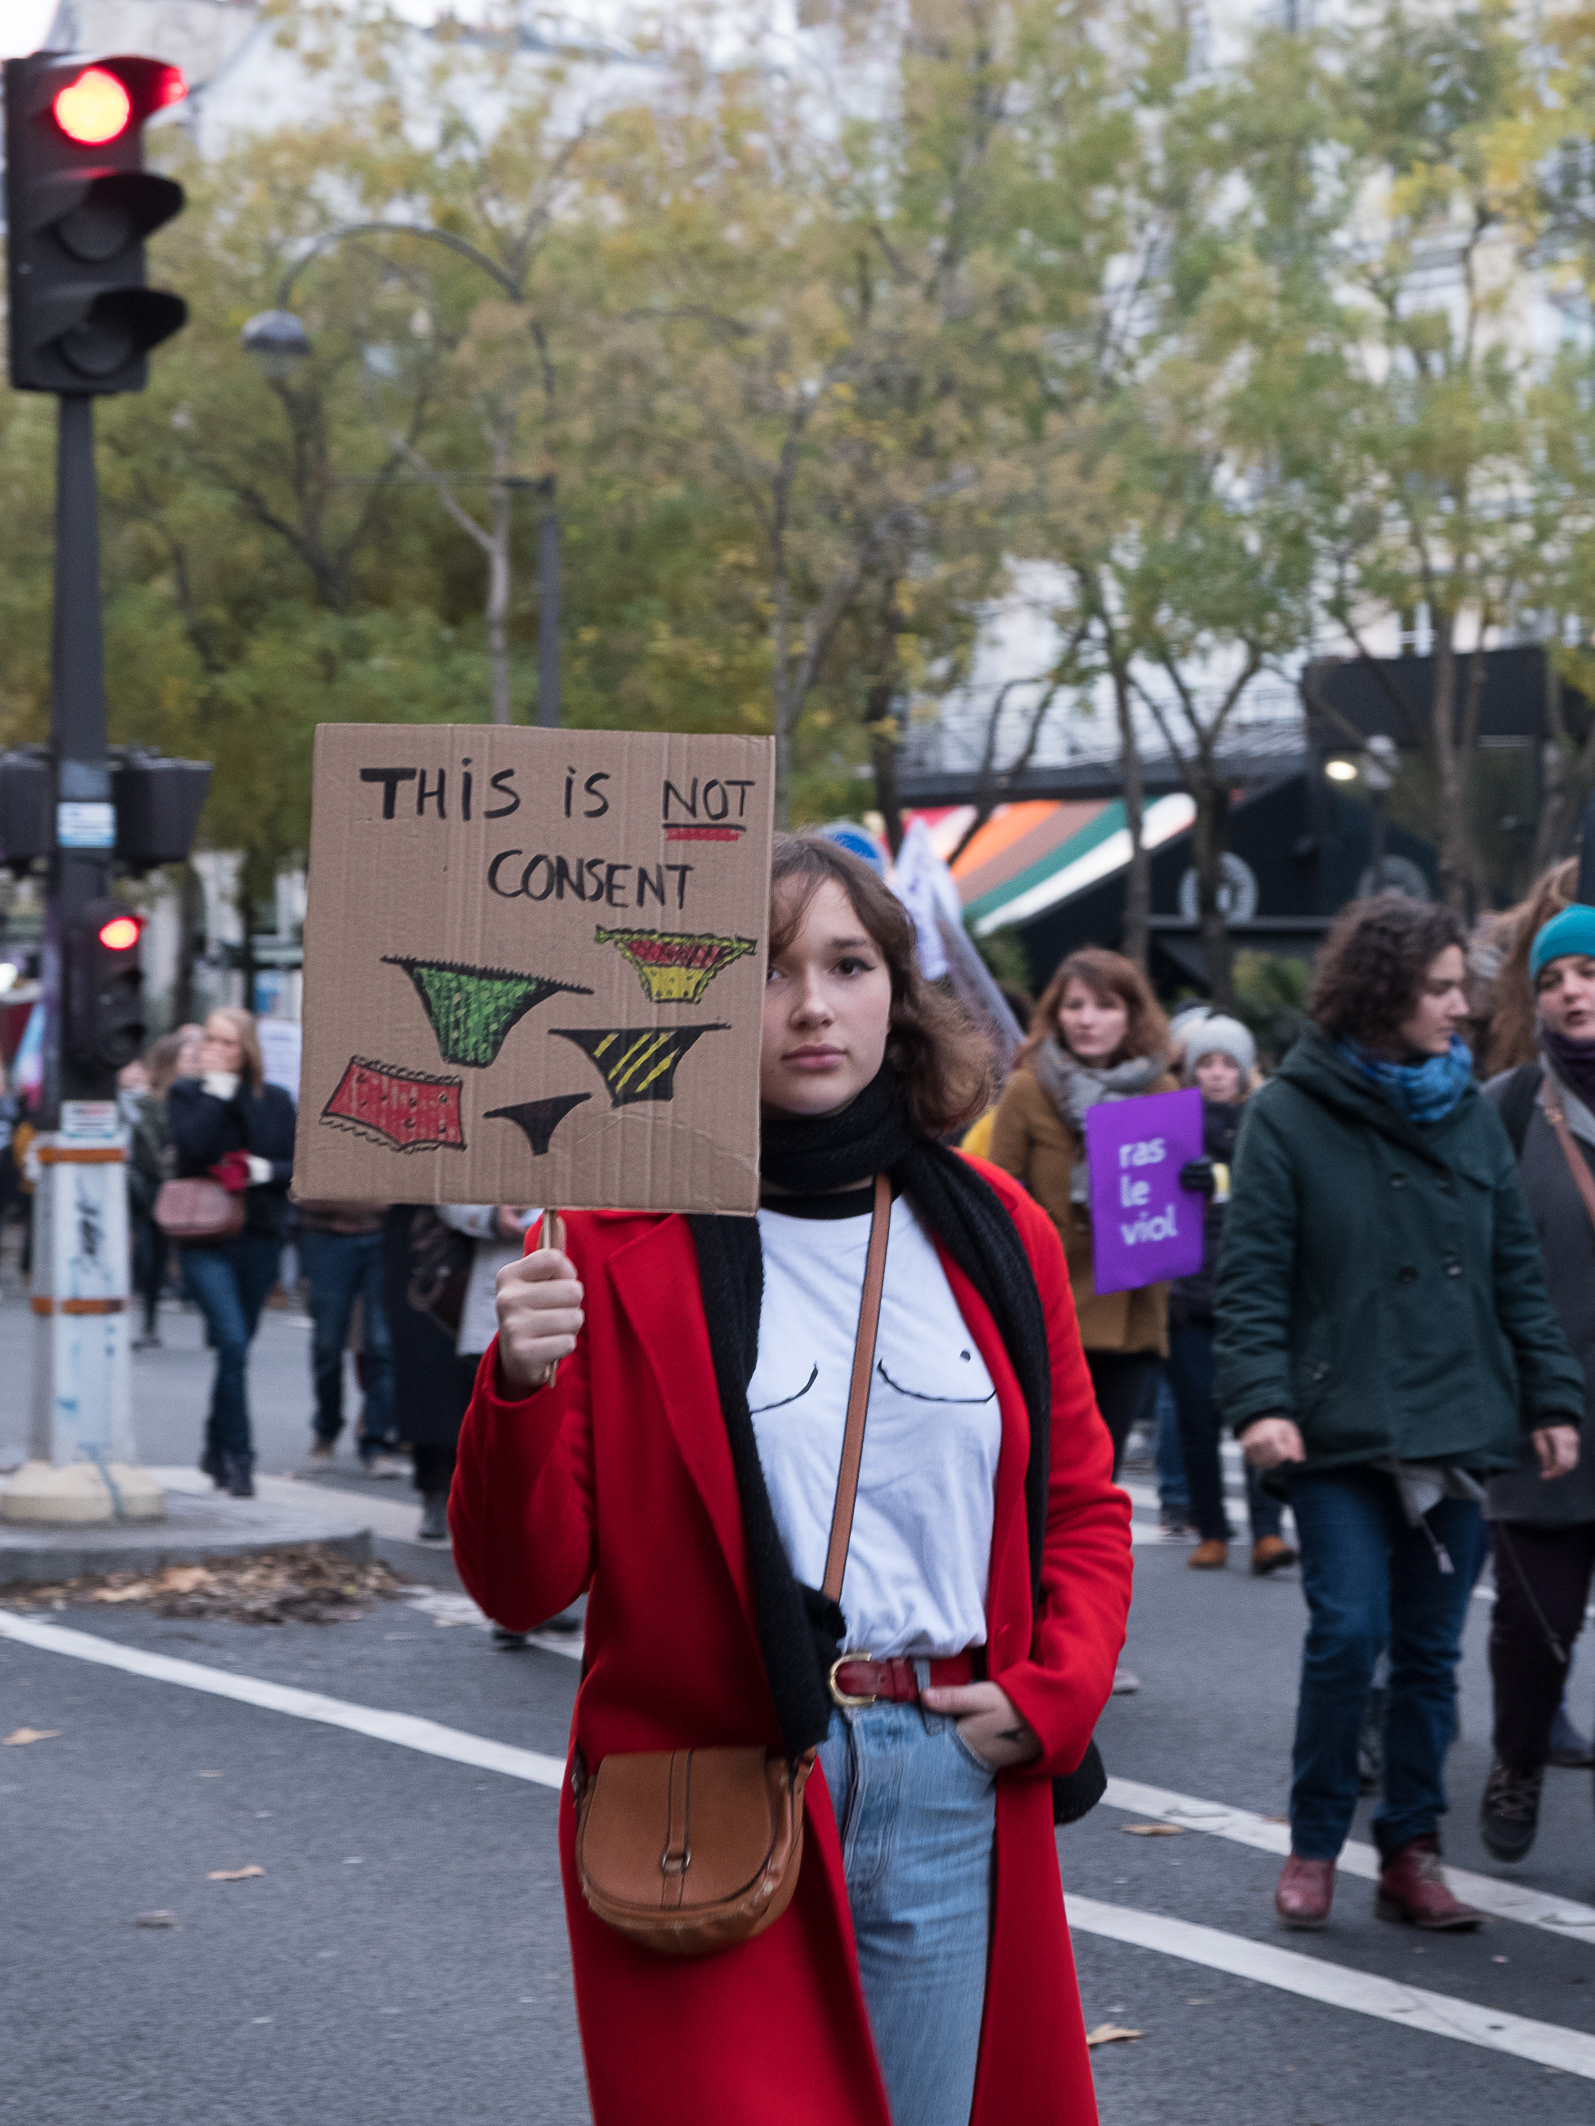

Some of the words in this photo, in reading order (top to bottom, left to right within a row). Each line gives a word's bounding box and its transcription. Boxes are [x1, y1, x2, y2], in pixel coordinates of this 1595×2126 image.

[662, 778, 756, 821] NOT
[488, 850, 694, 909] CONSENT
[1120, 1138, 1167, 1168] ras
[1120, 1175, 1150, 1207] le
[1121, 1204, 1177, 1245] viol
